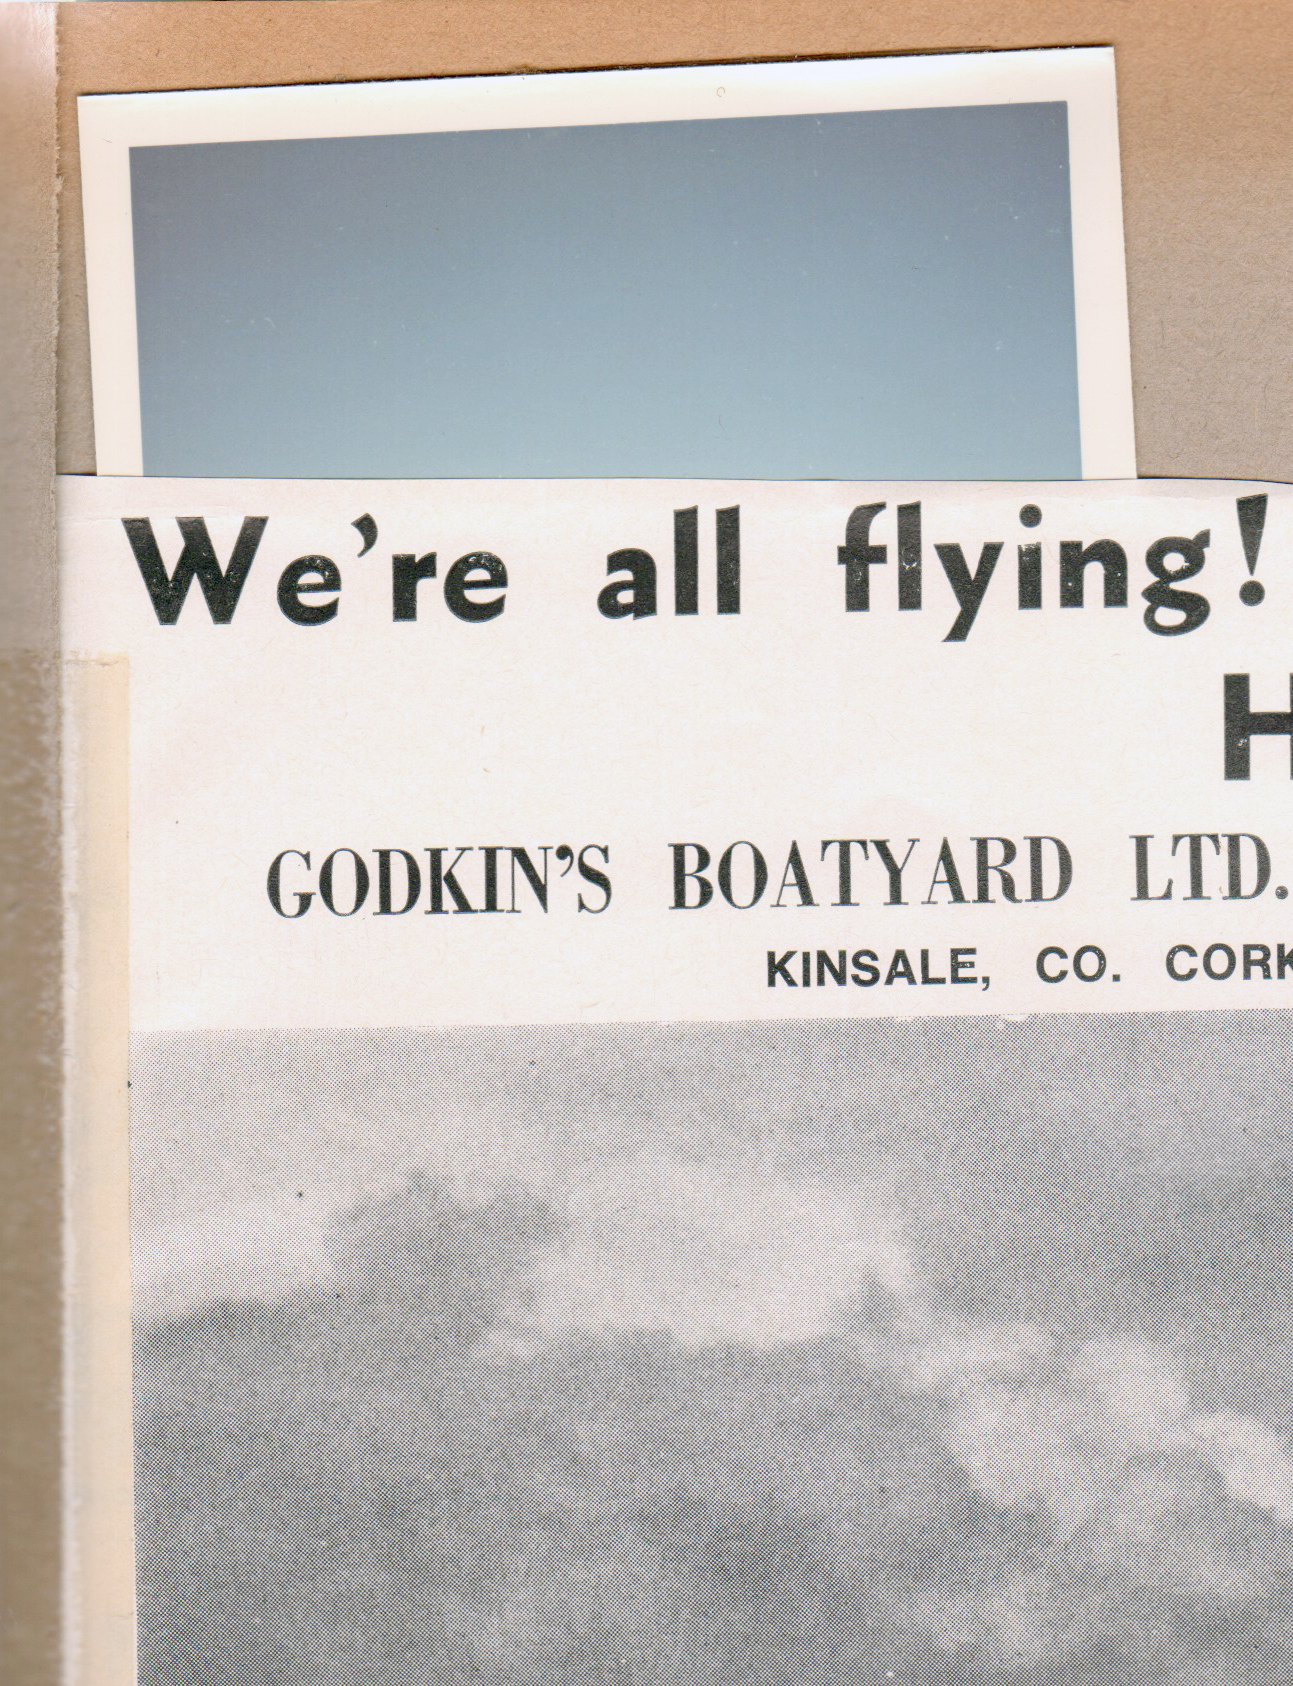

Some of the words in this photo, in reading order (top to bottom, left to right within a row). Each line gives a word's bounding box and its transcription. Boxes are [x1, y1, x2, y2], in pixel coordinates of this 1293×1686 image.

[122, 514, 507, 626] We're
[598, 506, 740, 619] all
[838, 494, 1267, 642] flying!
[267, 845, 611, 918] GODKIN'S
[670, 837, 1071, 909] BOATYARD
[1134, 835, 1288, 900] LTD.
[768, 948, 989, 990] KINSALE,
[1037, 946, 1120, 983] CO.
